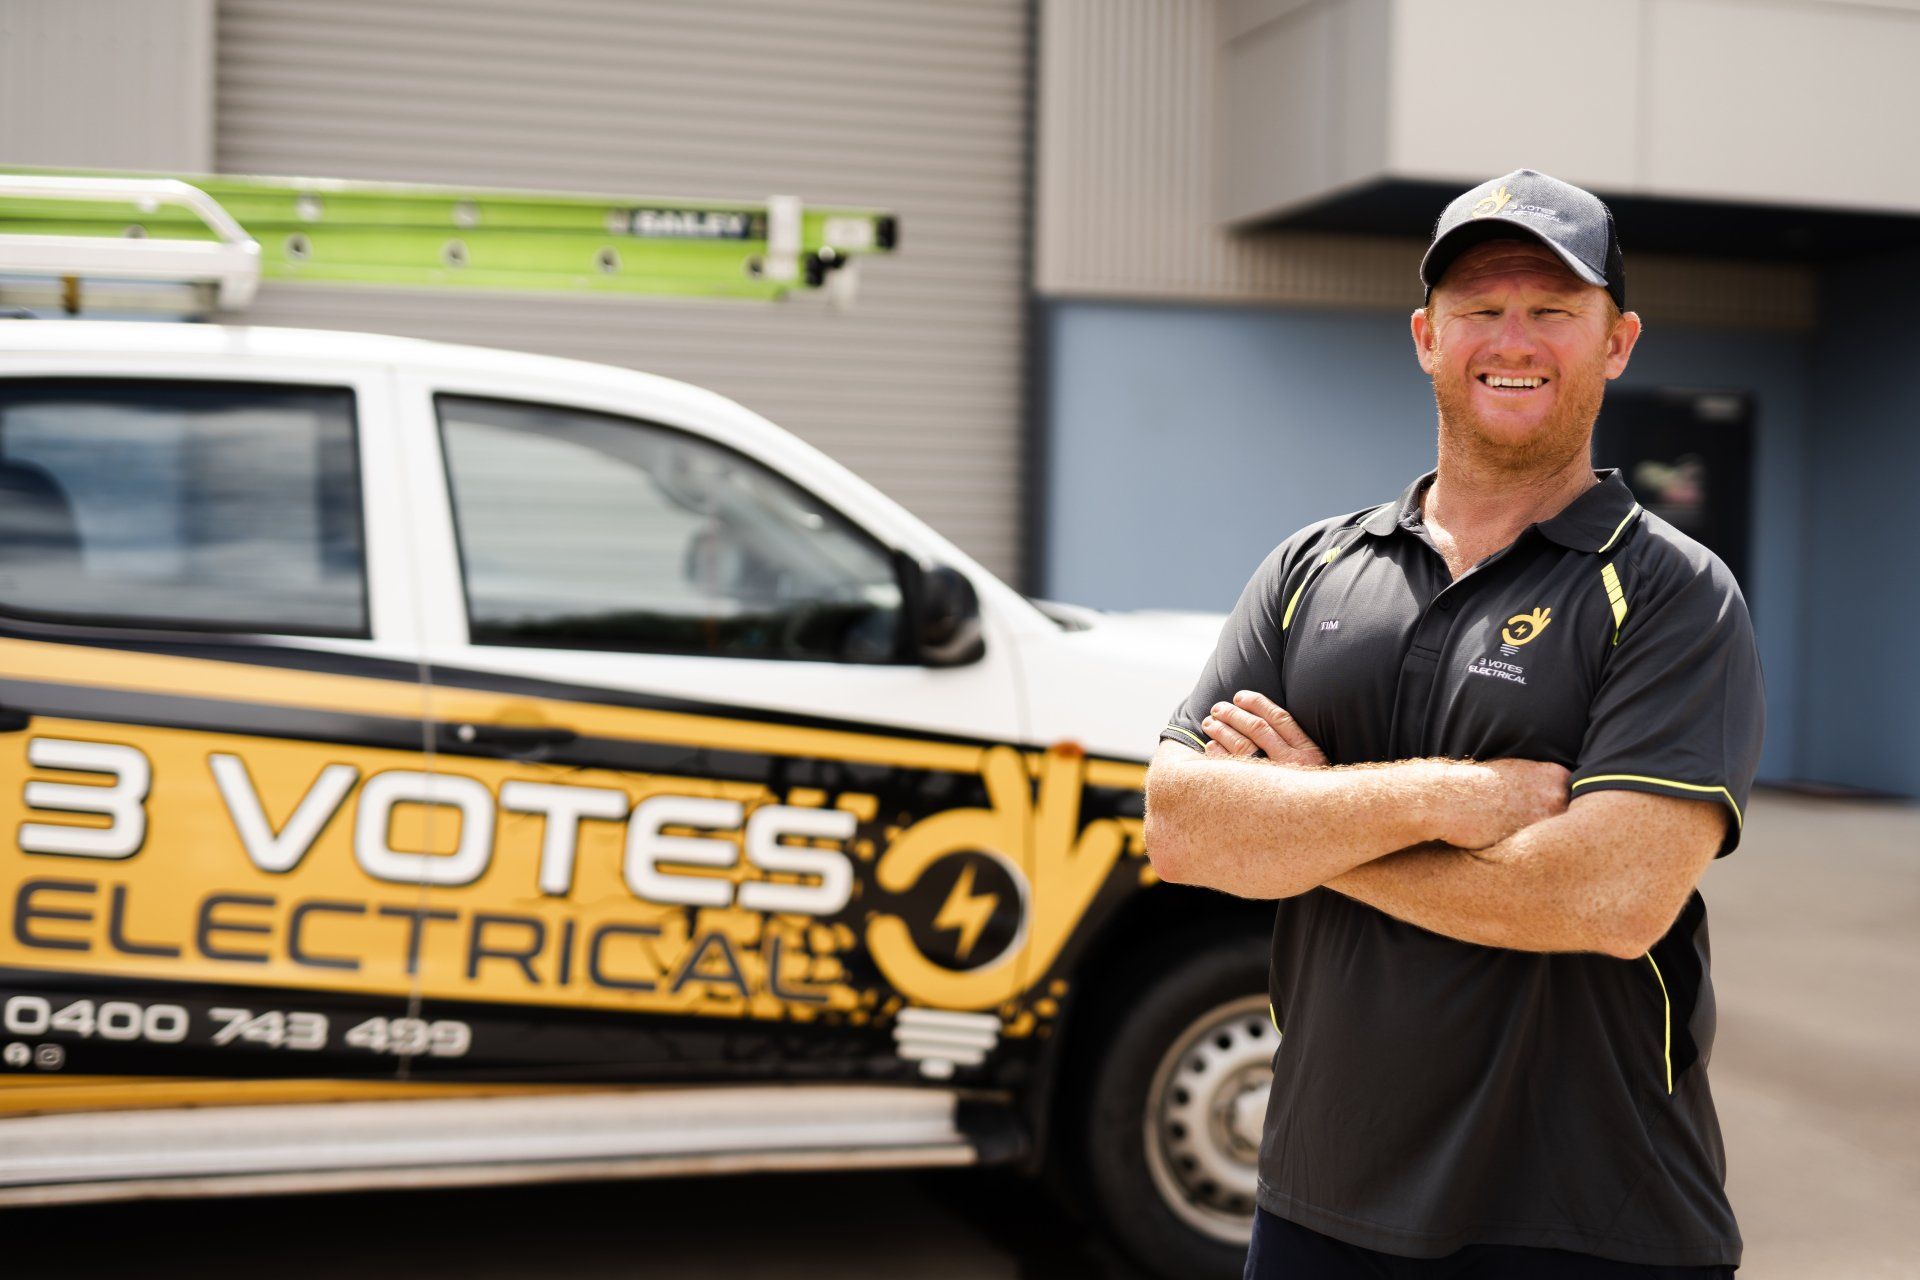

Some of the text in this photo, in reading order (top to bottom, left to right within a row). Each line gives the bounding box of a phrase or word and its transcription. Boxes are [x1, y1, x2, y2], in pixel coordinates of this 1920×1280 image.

[1501, 210, 1563, 223] ELECTRICAL
[1520, 204, 1556, 216] VOTES
[1320, 620, 1339, 630] TIM
[1468, 665, 1527, 684] ELECTRICAL
[1479, 657, 1524, 674] 3 VOTES
[17, 736, 859, 916] 3 VOTES
[12, 877, 830, 1004] ELECTRICAL
[4, 995, 472, 1058] 0400 743 499
